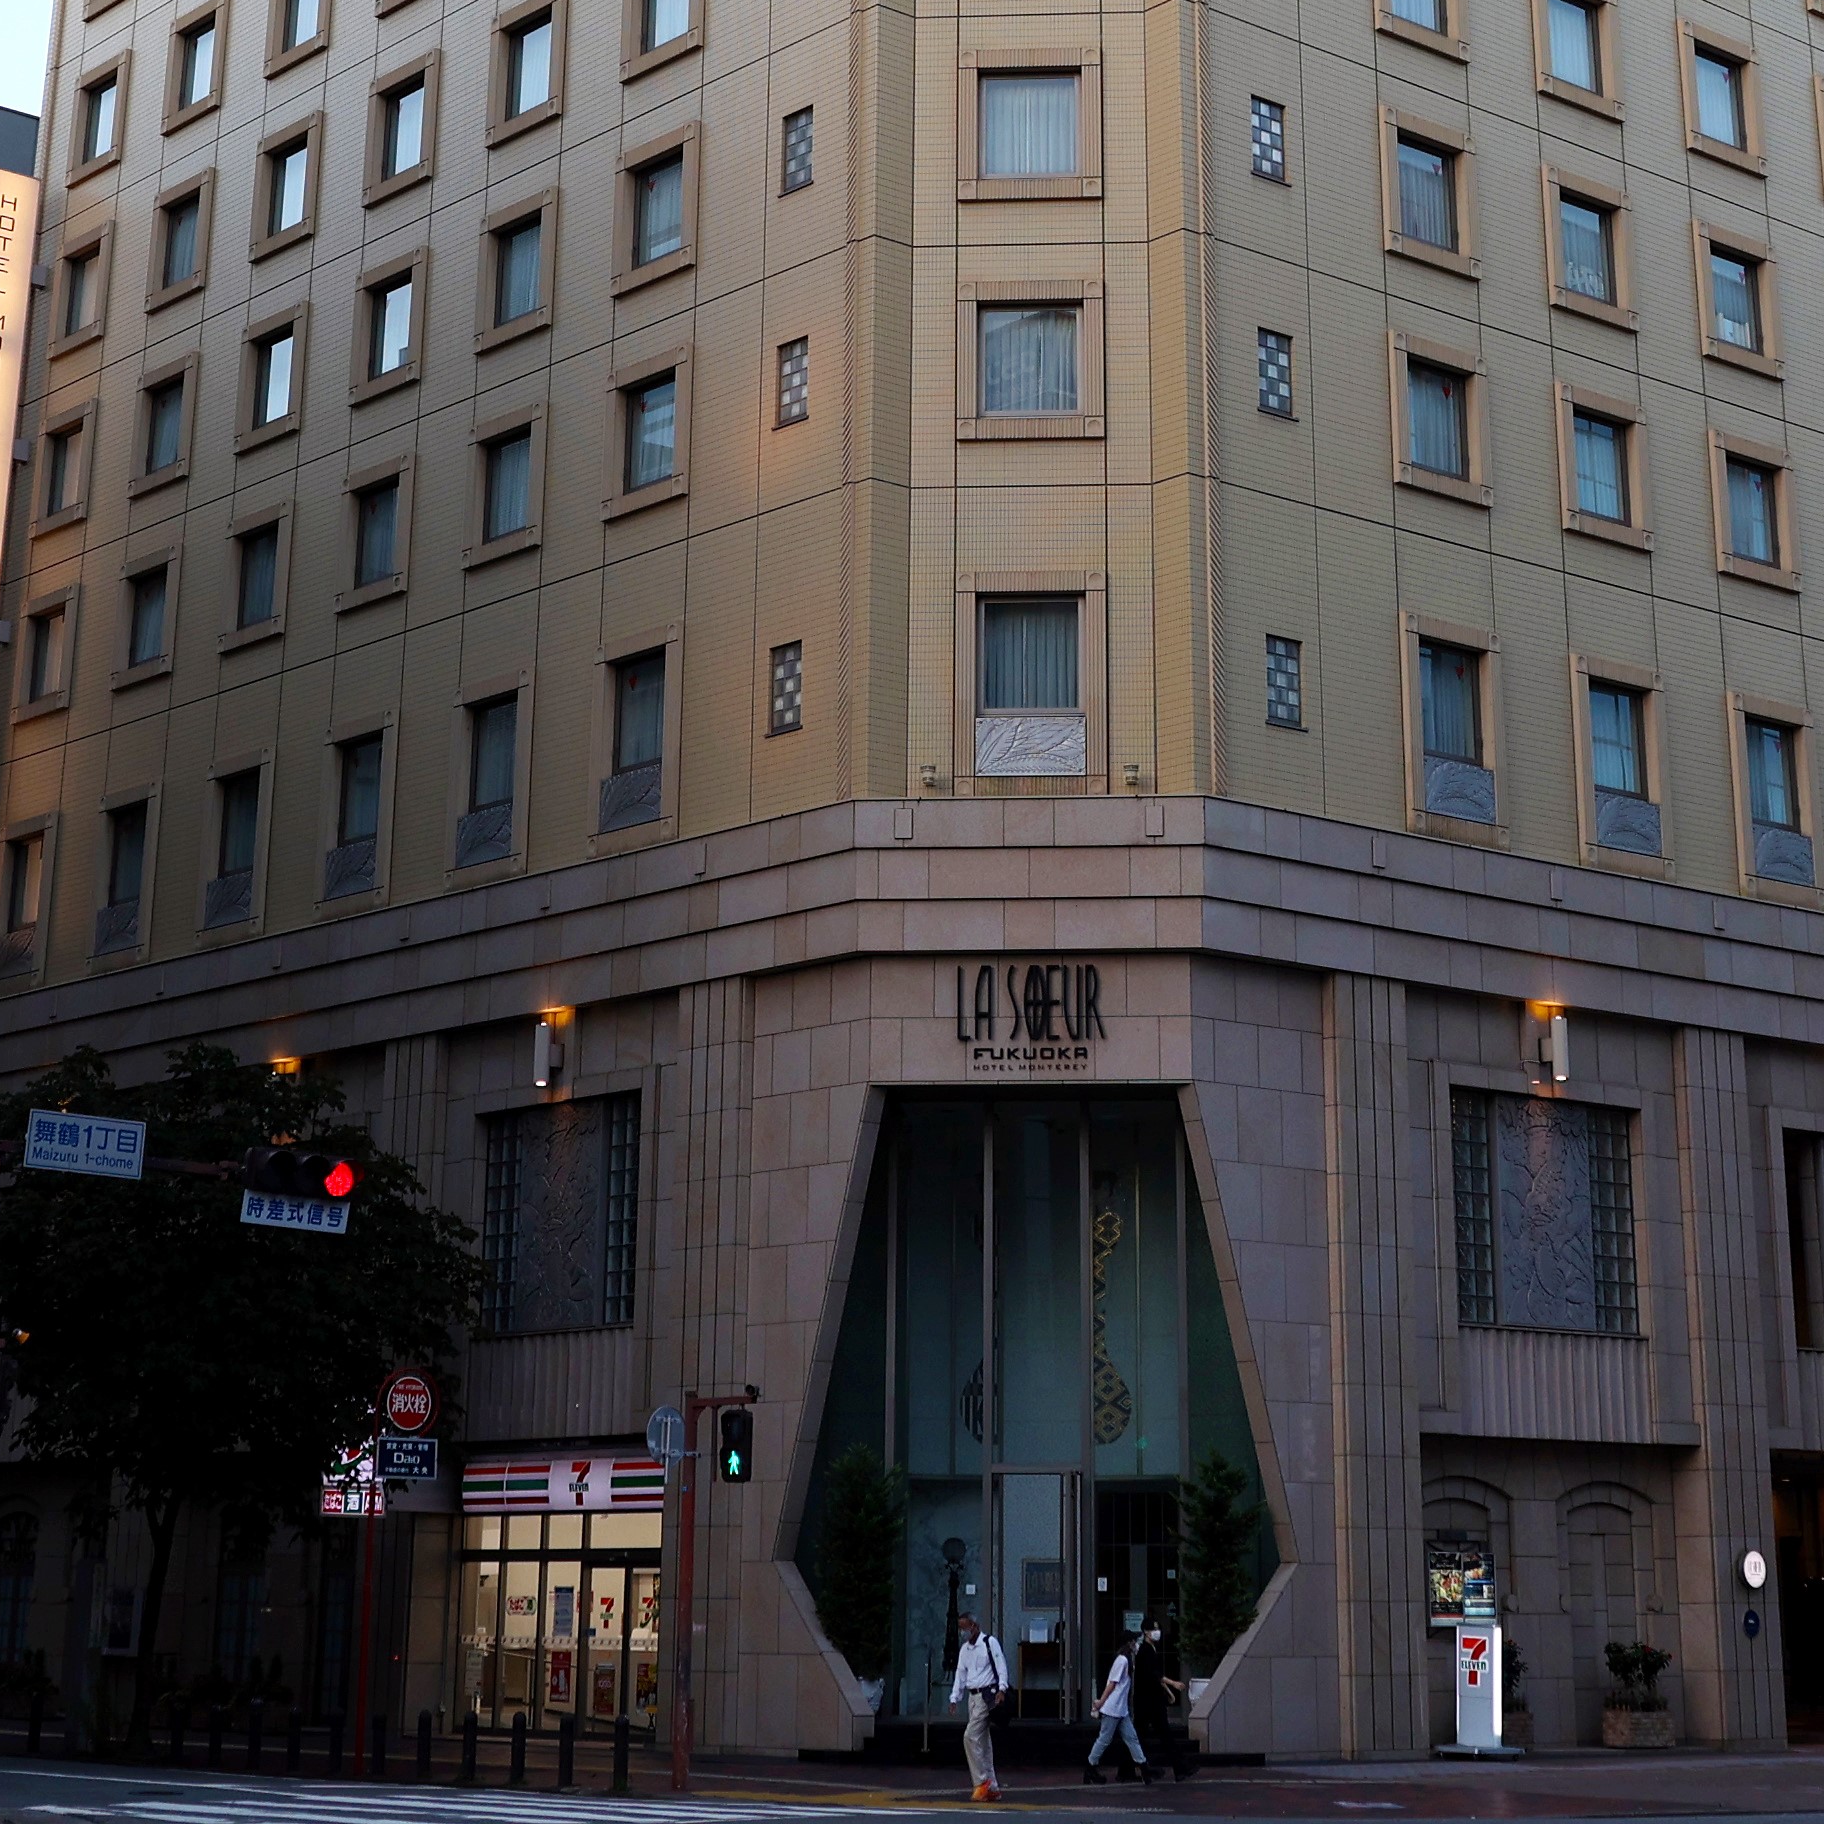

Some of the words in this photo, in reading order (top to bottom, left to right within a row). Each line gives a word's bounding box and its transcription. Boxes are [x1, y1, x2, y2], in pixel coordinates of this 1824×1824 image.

[957, 964, 992, 1041] LA
[974, 1047, 1088, 1060] FUKUOKA
[973, 1063, 1014, 1071] HOTEL
[33, 1117, 138, 1155] 舞鶴1丁目
[31, 1146, 79, 1165] Maizuru
[84, 1153, 134, 1170] 1-chome
[245, 1196, 344, 1228] 時差式信号
[392, 1393, 427, 1413] 消火栓
